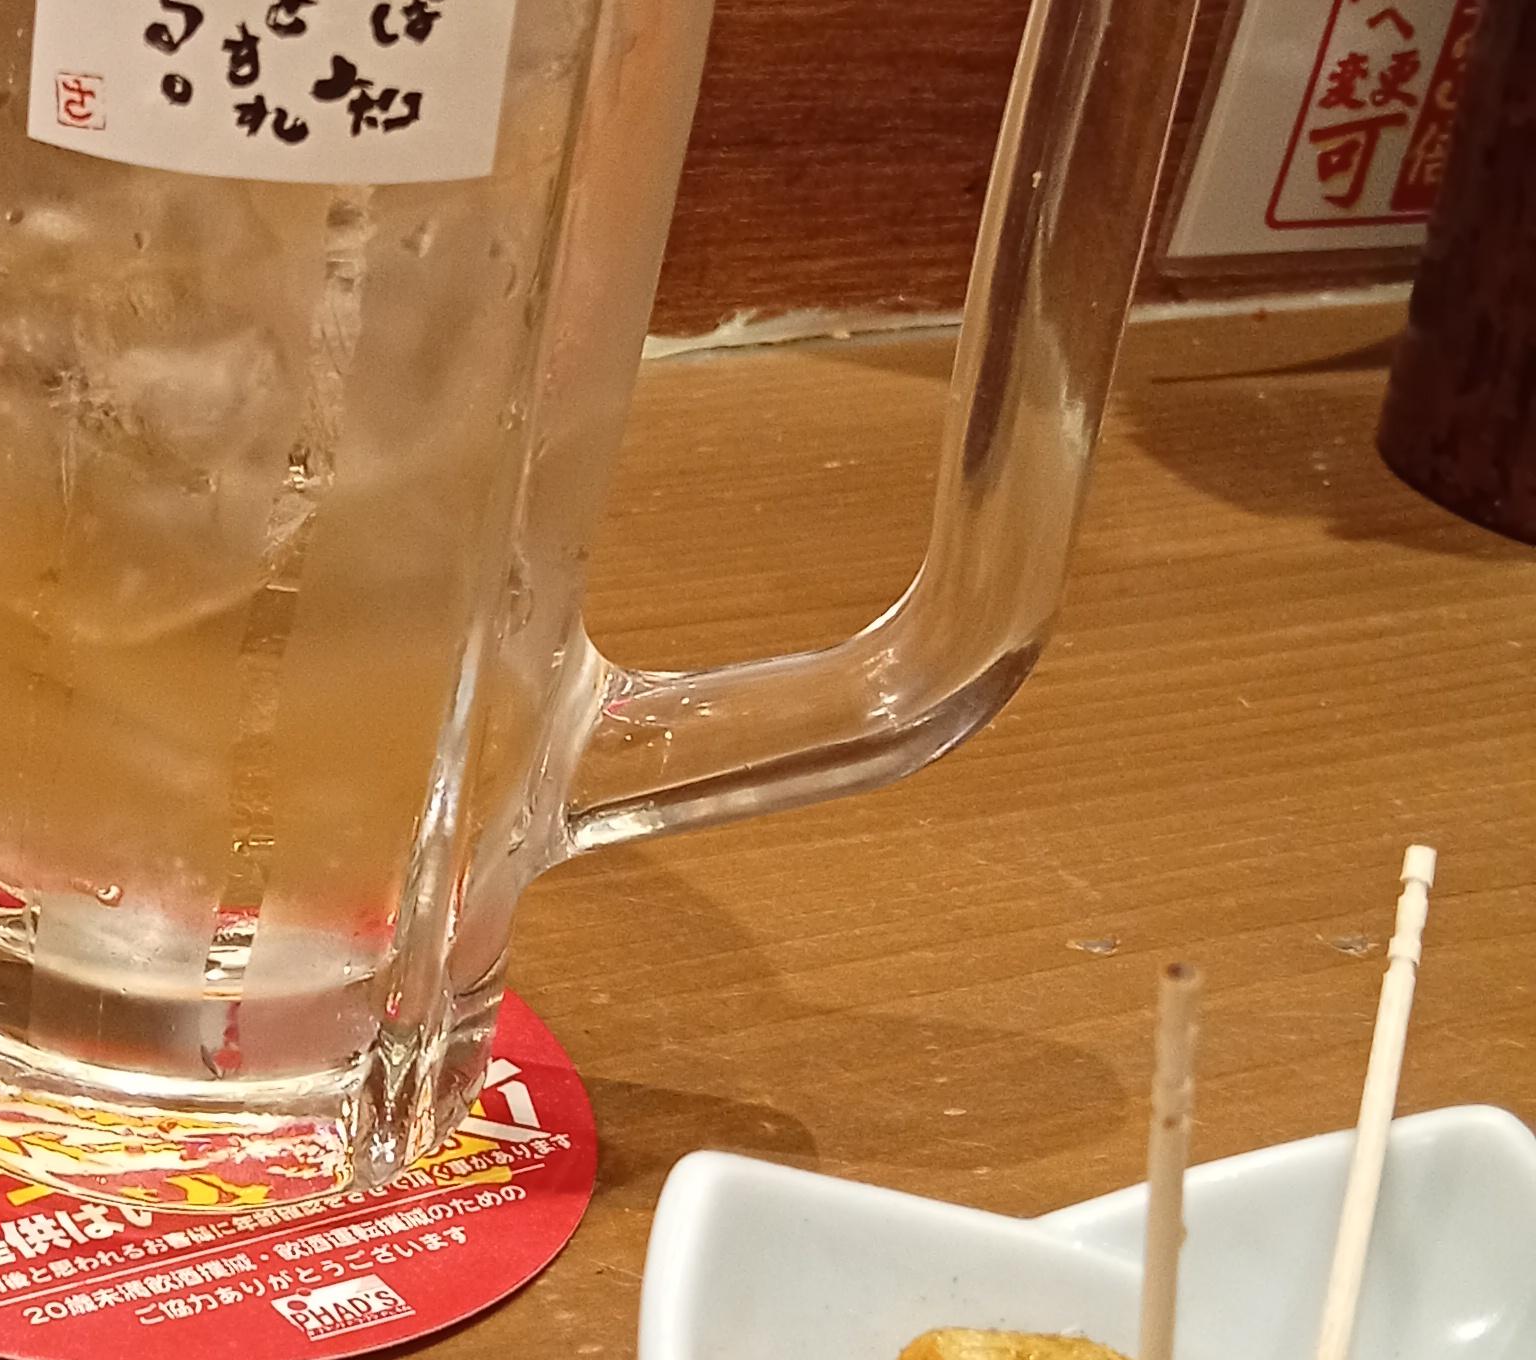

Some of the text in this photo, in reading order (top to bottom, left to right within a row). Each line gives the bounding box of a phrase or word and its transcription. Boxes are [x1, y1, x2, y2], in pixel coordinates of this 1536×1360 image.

[1318, 50, 1421, 110] 変更
[1308, 112, 1410, 211] 可
[134, 1224, 468, 1326] ご協力ありがとうございます
